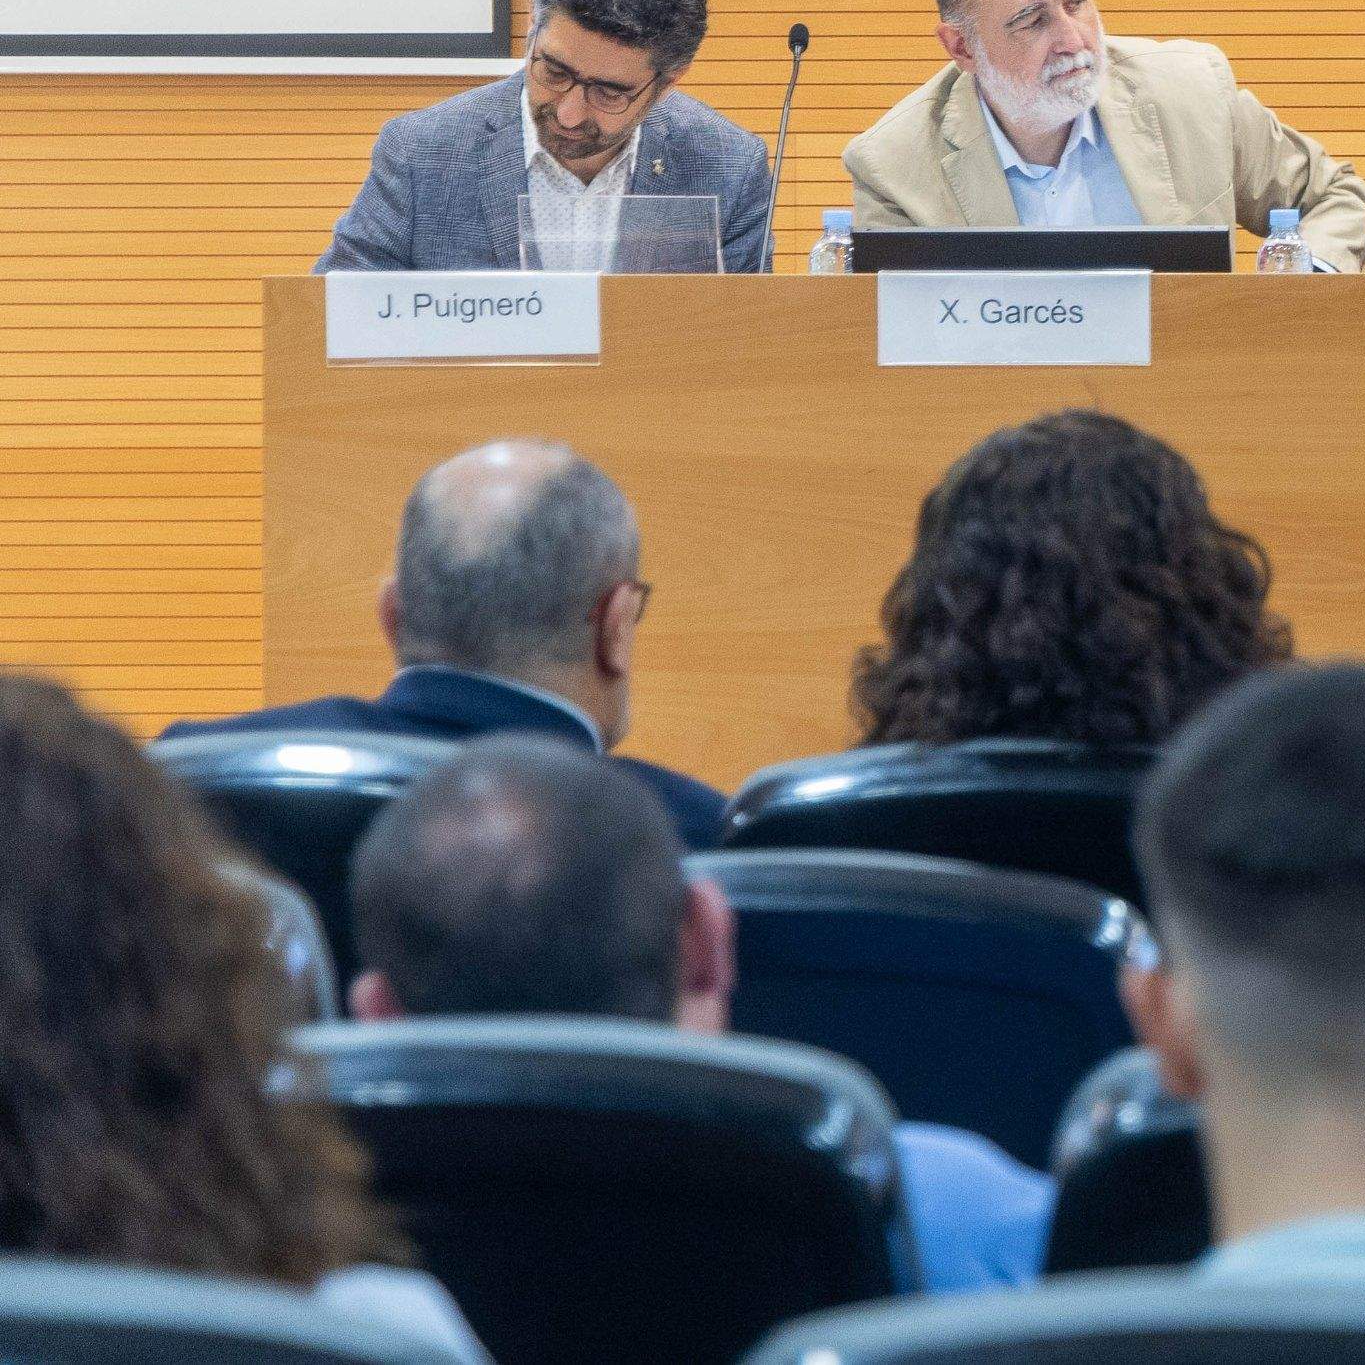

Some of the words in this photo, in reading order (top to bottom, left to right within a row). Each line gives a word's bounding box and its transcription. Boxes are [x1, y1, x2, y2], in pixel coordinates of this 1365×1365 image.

[378, 294, 401, 319] J.
[413, 290, 543, 324] Puigneró
[939, 299, 967, 324] X.
[980, 298, 1084, 324] Garcés
